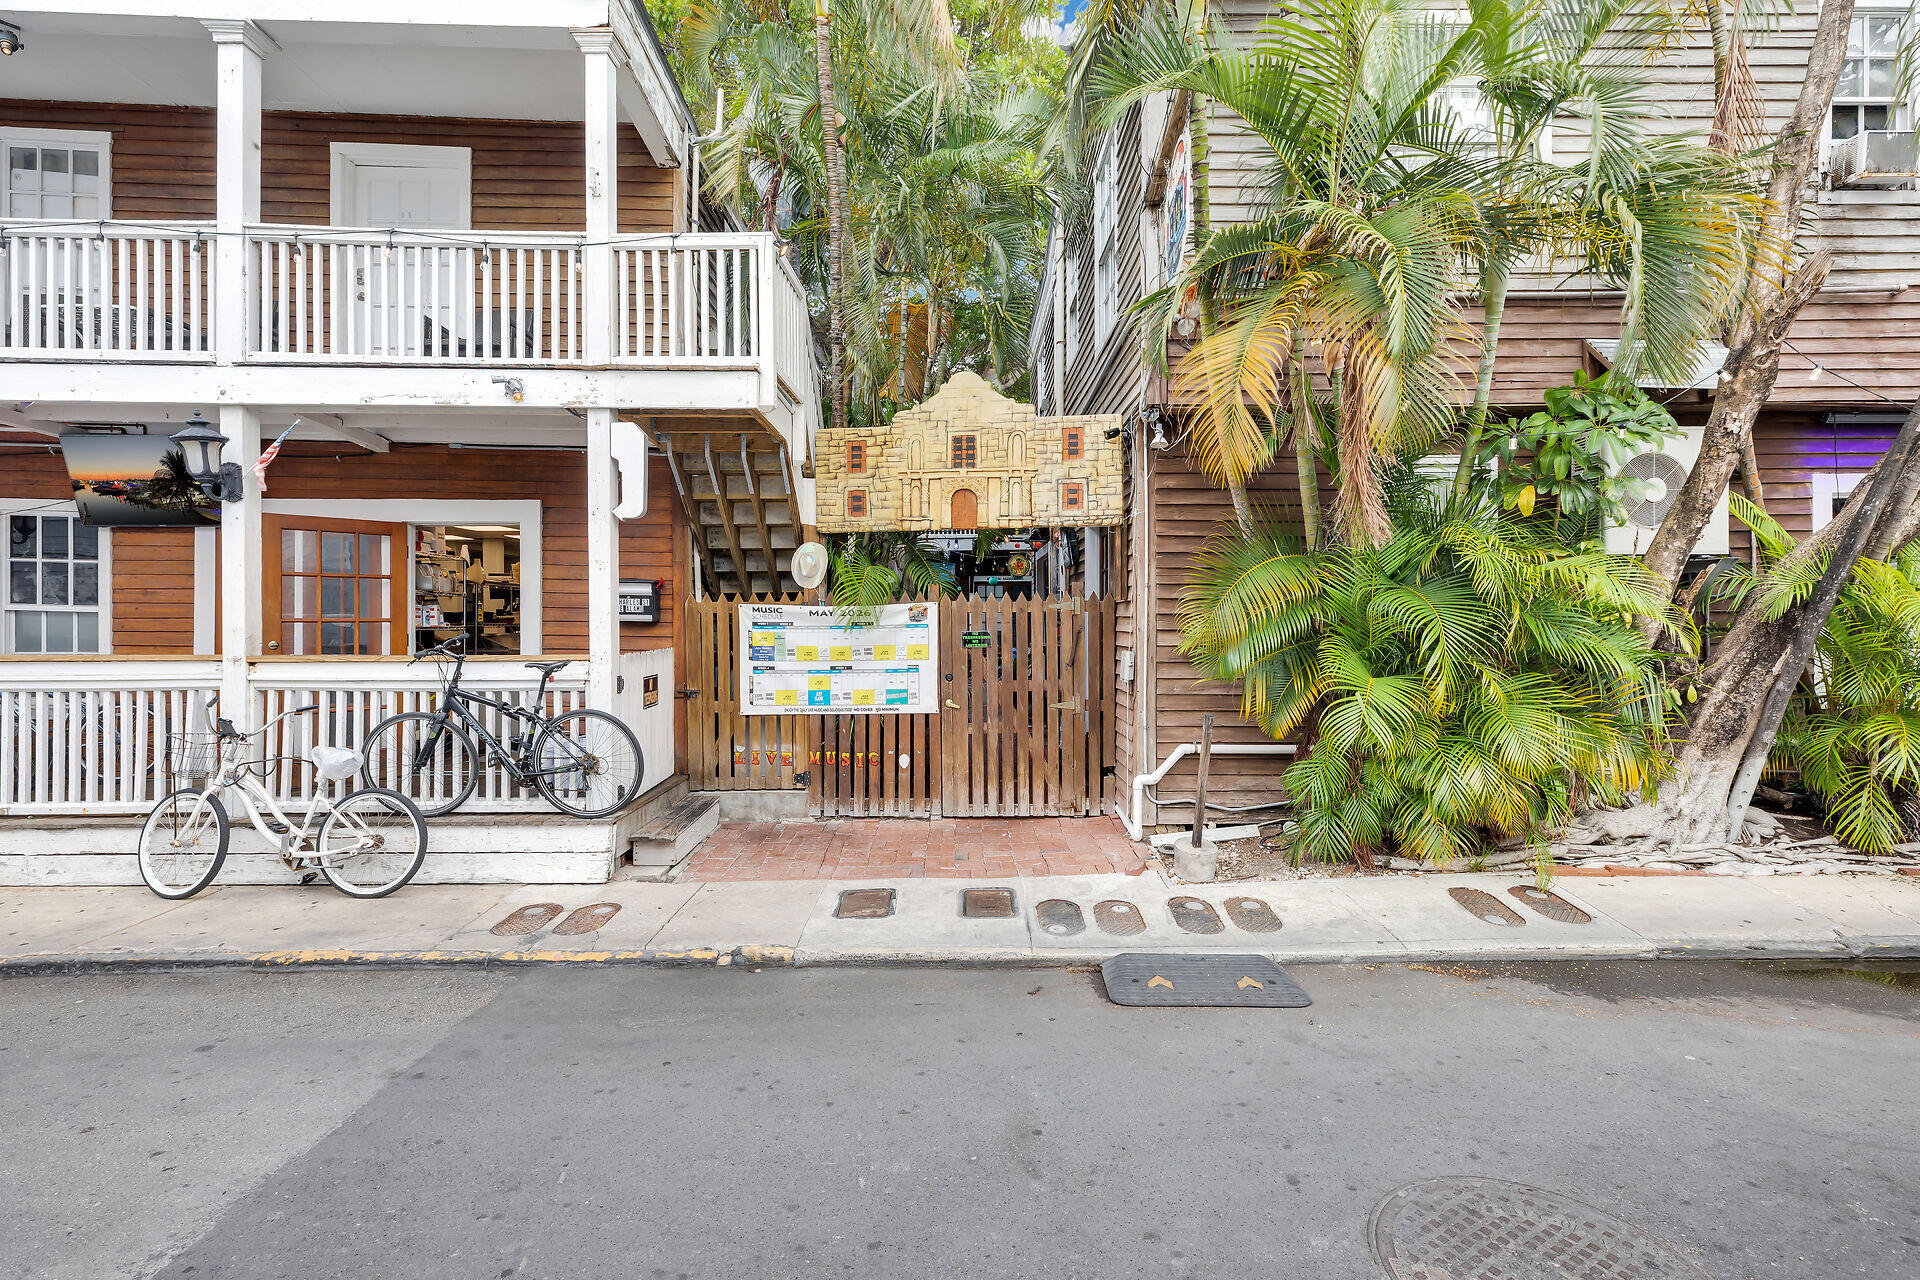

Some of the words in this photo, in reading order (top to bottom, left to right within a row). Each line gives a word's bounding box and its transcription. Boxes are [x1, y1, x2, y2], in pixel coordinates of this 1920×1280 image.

[752, 606, 783, 614] MUSIC
[840, 609, 872, 617] 2026
[733, 750, 793, 766] LIVE
[808, 750, 881, 768] MUSIC
